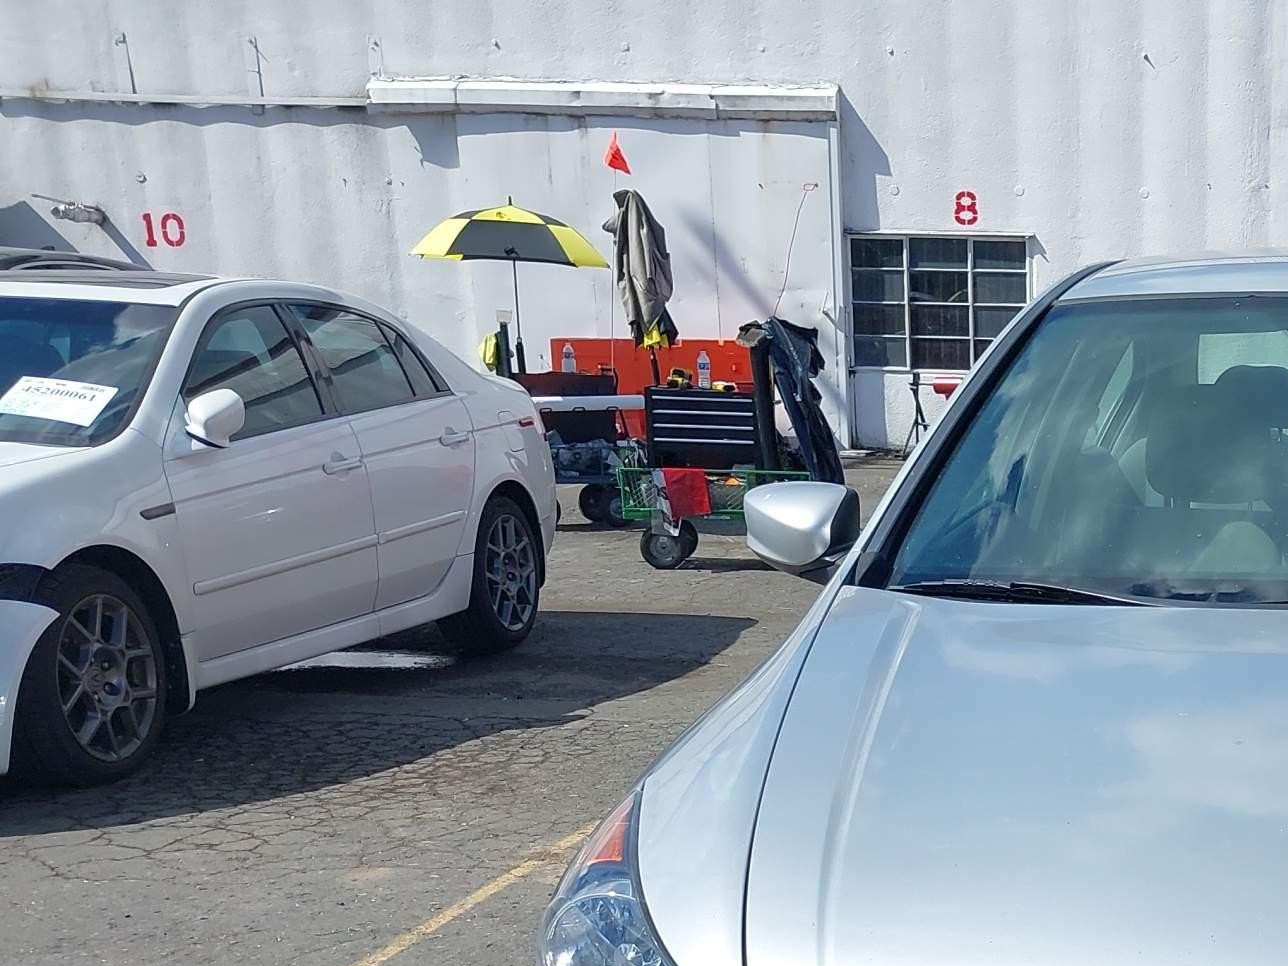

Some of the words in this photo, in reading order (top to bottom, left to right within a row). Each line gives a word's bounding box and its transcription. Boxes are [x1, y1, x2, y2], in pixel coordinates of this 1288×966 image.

[954, 191, 978, 226] 8
[142, 213, 185, 248] 10
[21, 385, 97, 402] 45200061
